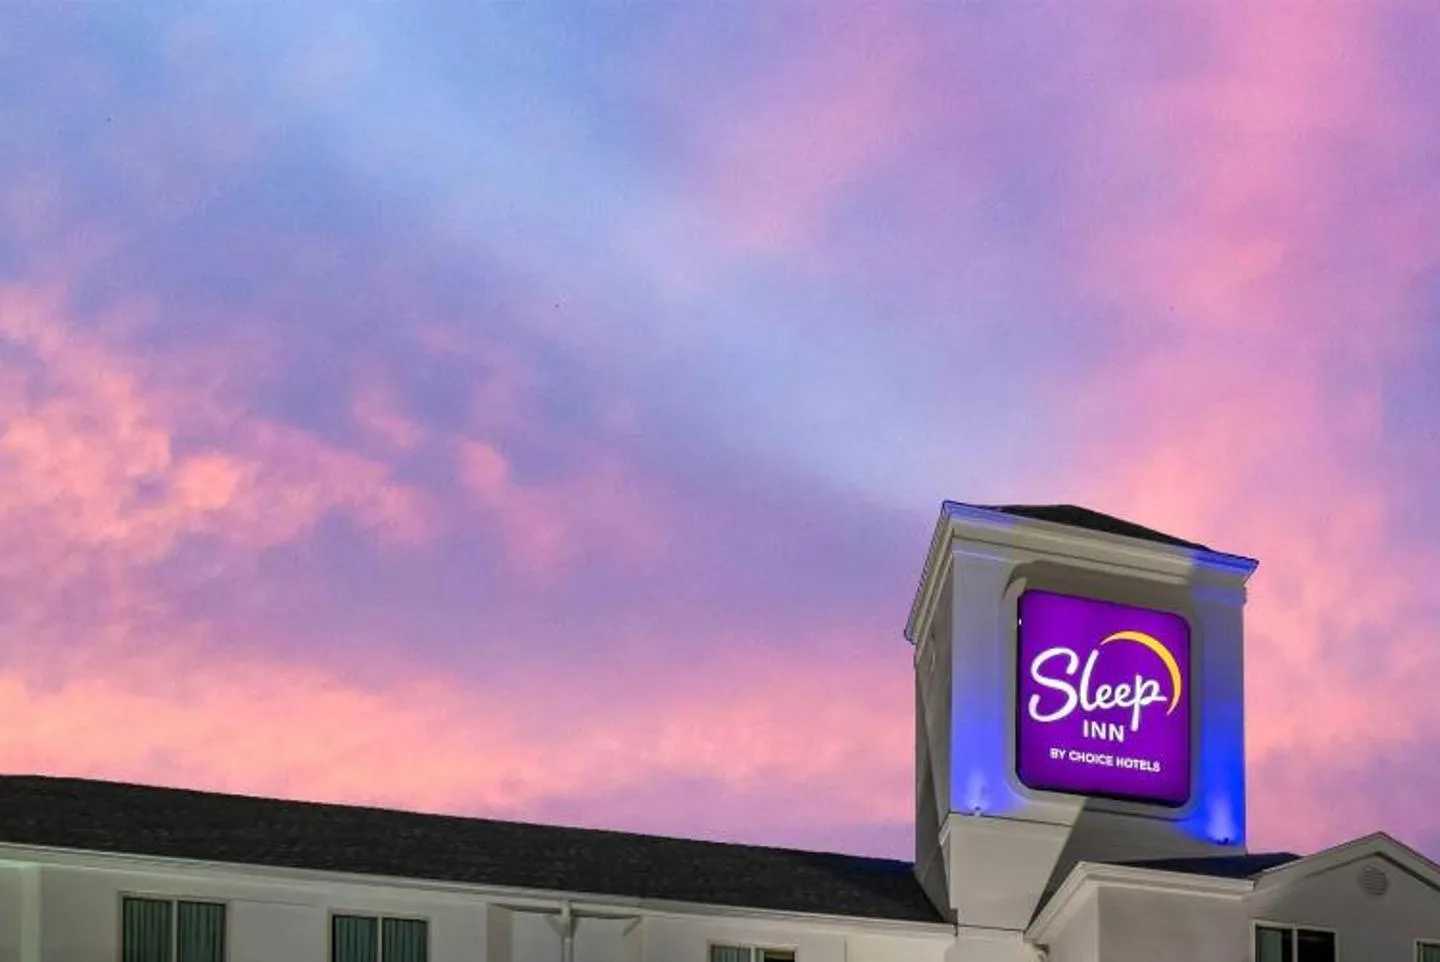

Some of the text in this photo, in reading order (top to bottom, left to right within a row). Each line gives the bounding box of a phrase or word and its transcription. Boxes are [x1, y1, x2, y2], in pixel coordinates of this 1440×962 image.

[1028, 647, 1168, 732] Sleep
[1083, 720, 1125, 743] INN
[1050, 748, 1161, 773] BY CHOICE HOTELS
